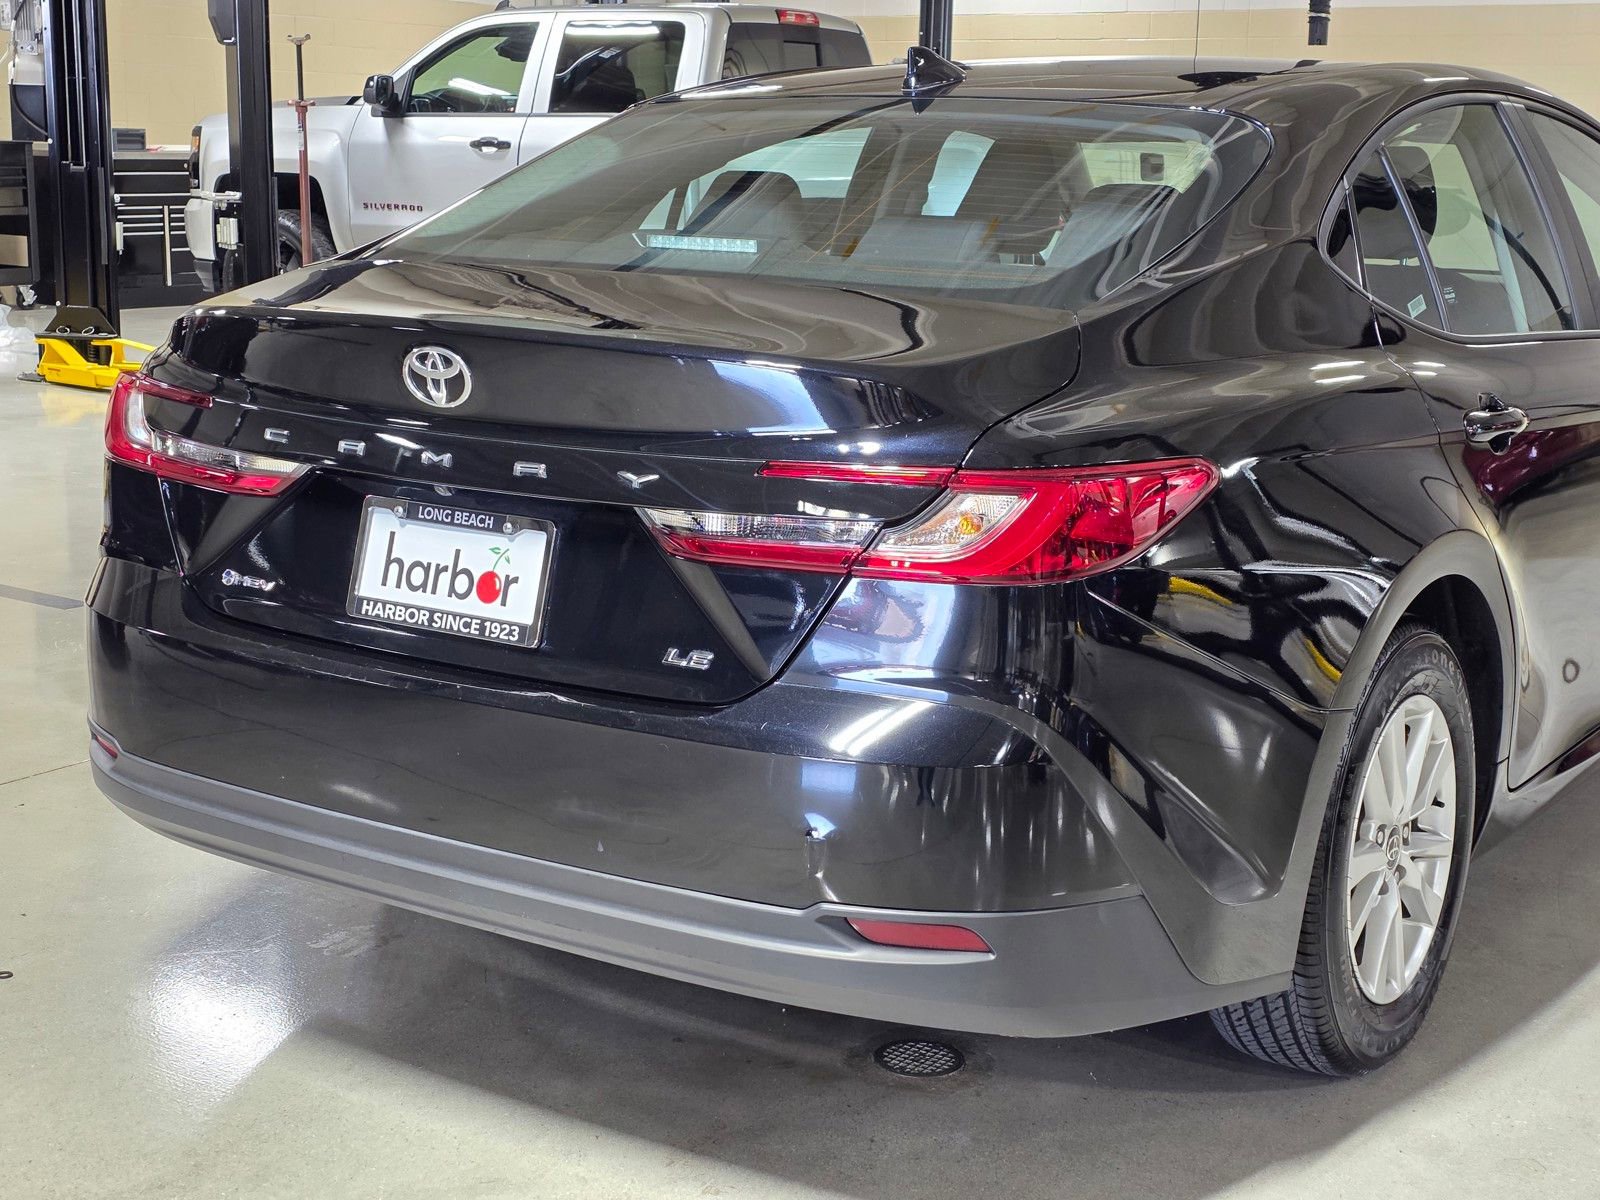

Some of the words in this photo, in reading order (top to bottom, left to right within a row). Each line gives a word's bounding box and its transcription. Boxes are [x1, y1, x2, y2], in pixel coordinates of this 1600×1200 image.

[362, 202, 423, 212] SILVERADO
[263, 427, 660, 488] CAMRY
[418, 505, 451, 522] LONG
[454, 511, 494, 529] BEACH
[381, 531, 520, 607] harbor
[361, 600, 429, 626] HARBOR
[432, 613, 480, 636] SINCE
[483, 621, 520, 642] 1923
[662, 647, 715, 671] LE
